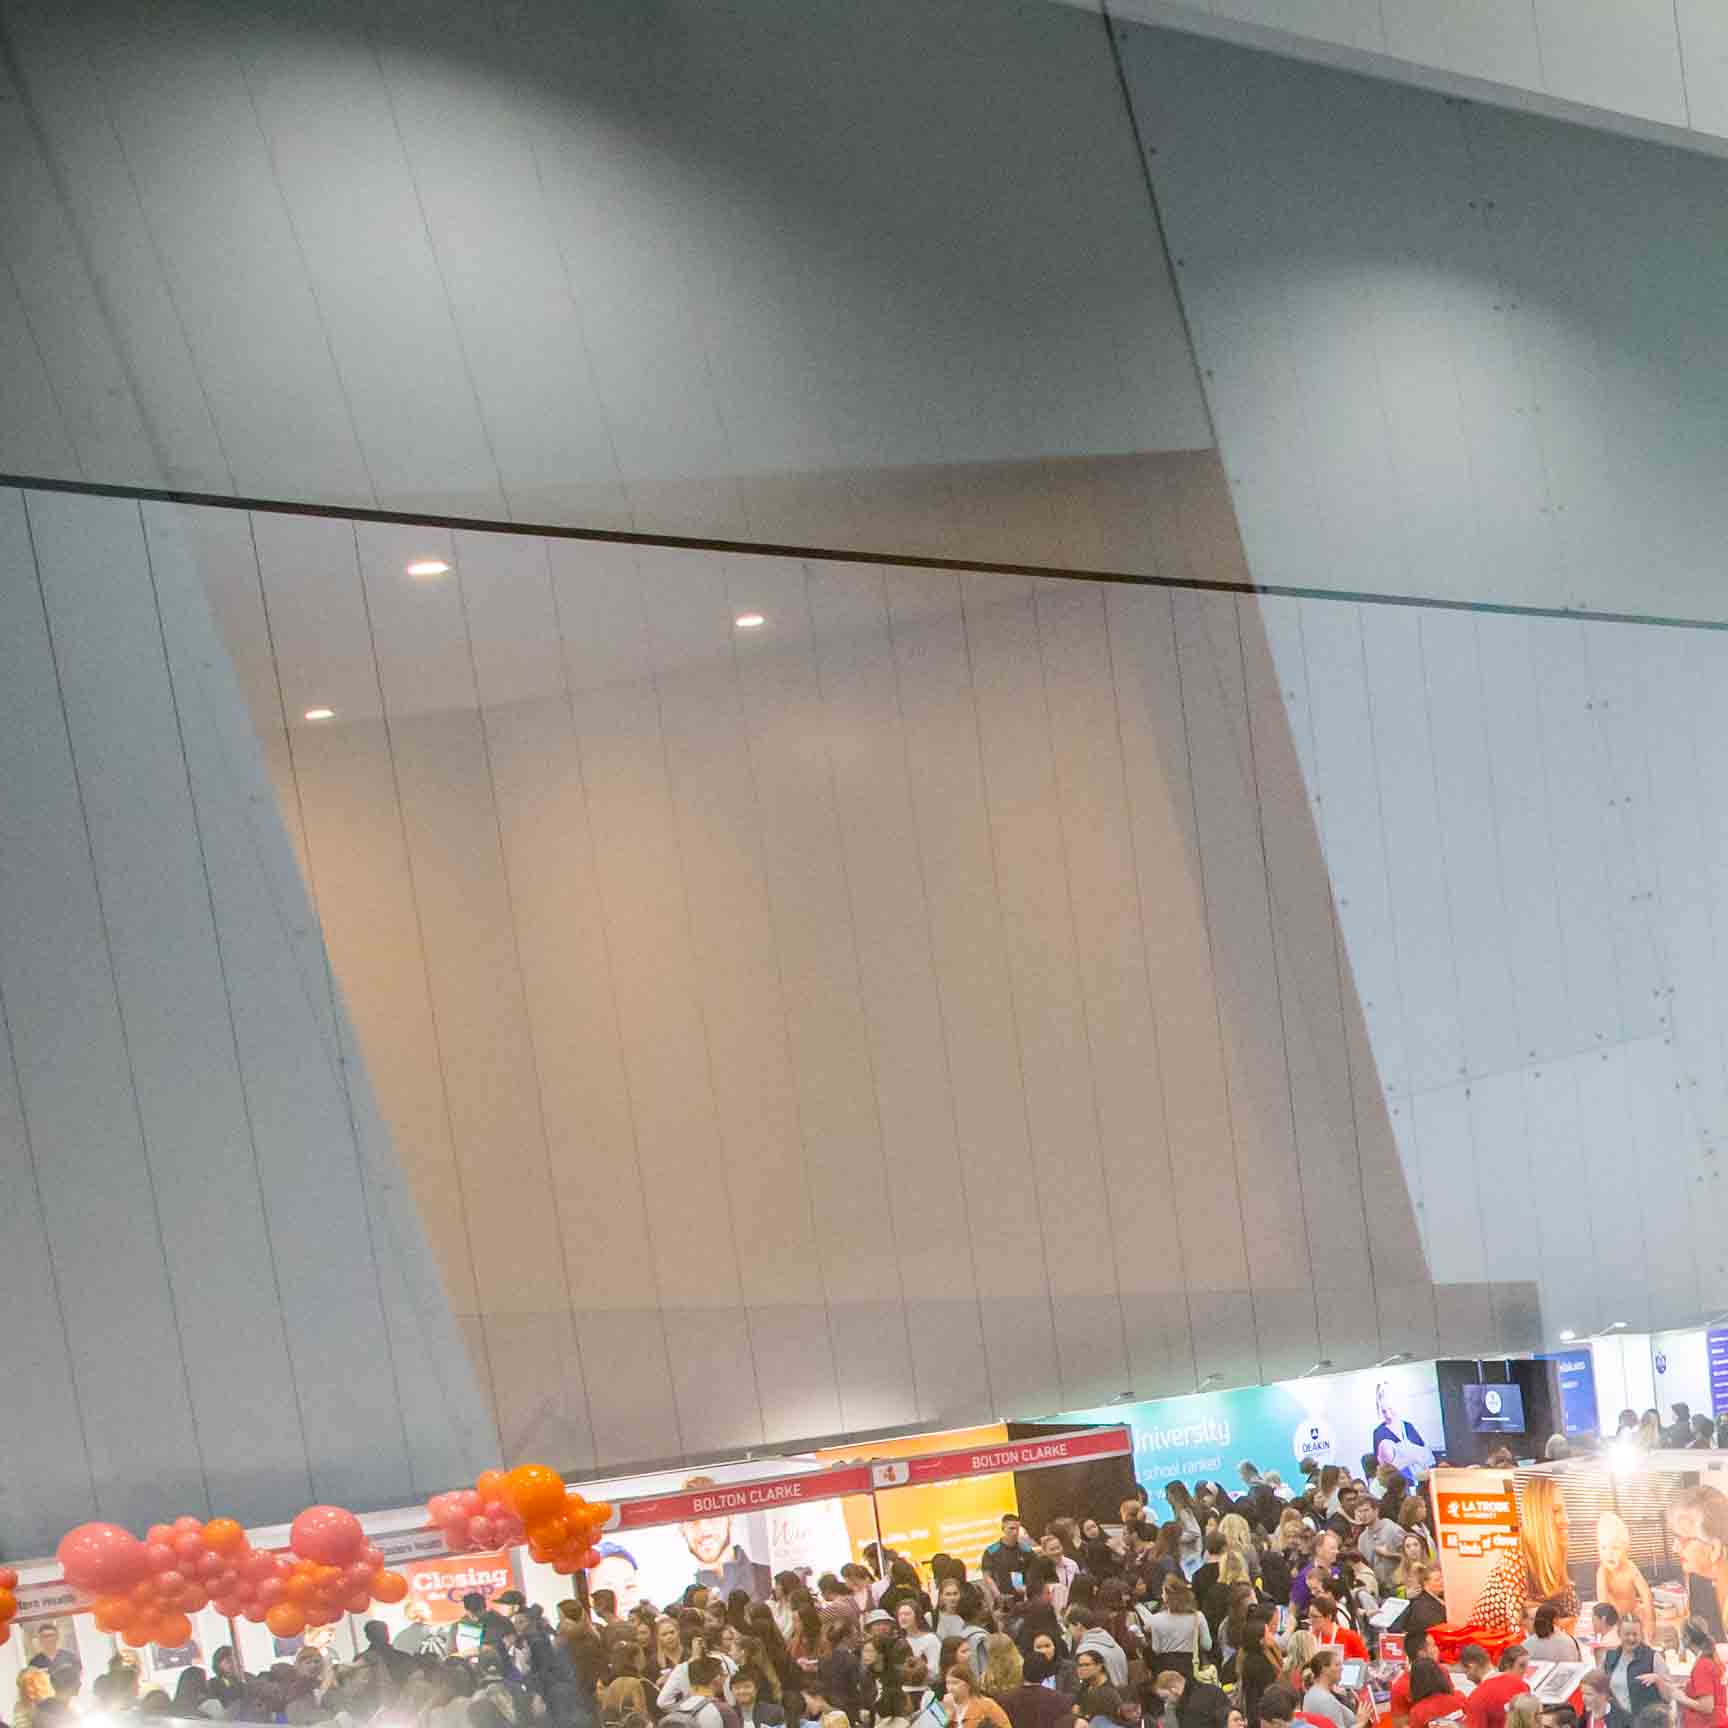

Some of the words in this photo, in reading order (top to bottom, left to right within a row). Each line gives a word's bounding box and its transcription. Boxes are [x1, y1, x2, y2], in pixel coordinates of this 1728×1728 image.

[972, 1449, 1019, 1470] BOLTON
[1021, 1443, 1067, 1464] CLARKE
[1302, 1439, 1330, 1453] DEAKIN
[692, 1491, 746, 1513] BOLTON
[749, 1483, 802, 1505] CLARKE
[411, 1566, 508, 1591] Closing
